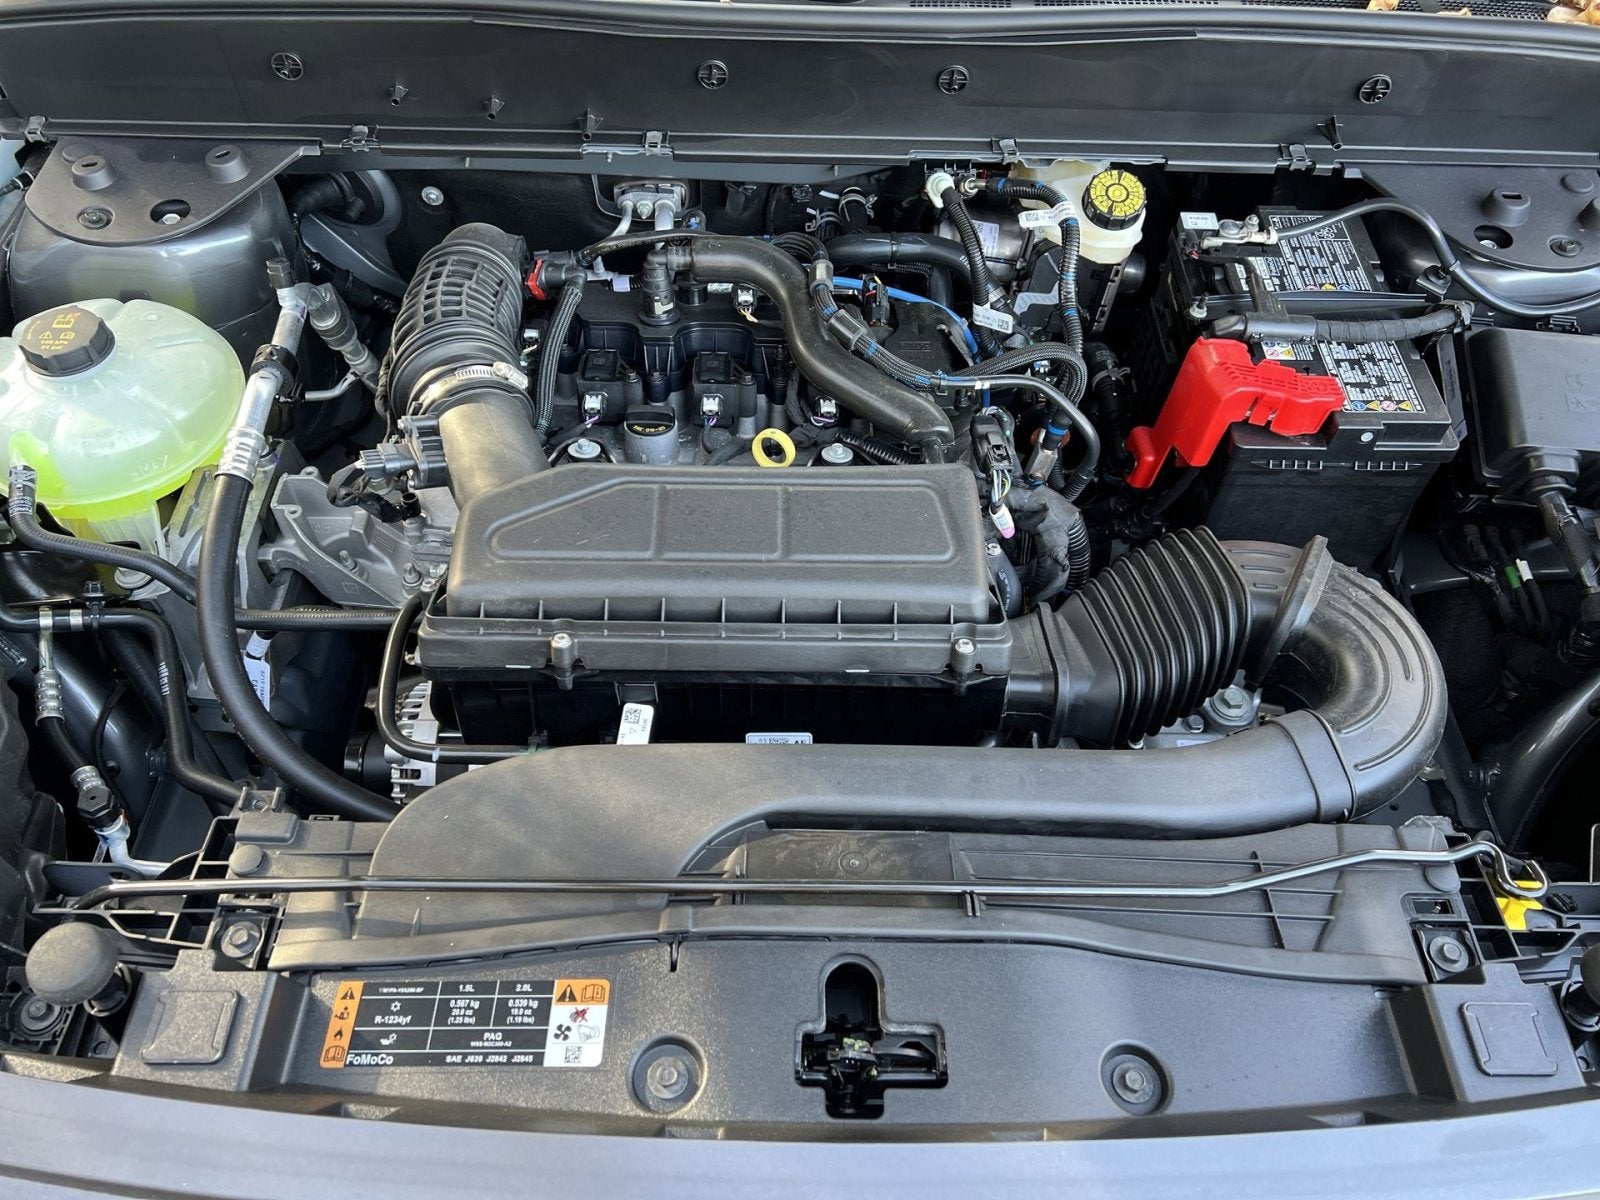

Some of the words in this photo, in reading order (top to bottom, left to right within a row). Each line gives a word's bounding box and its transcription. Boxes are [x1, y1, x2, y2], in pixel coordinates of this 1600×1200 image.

[459, 984, 475, 992] 1.5L
[515, 984, 532, 992] 2.0L
[450, 999, 468, 1007] 0.567
[470, 999, 480, 1008] kg
[508, 999, 528, 1007] 0.539
[528, 999, 538, 1008] kg
[374, 1015, 411, 1024] R-1234yf
[448, 1016, 463, 1024] (1.25
[464, 1016, 476, 1024] lbs)
[506, 1016, 521, 1024] (1.19
[522, 1016, 534, 1024] lbs)
[483, 1032, 502, 1040] PAG
[346, 1054, 394, 1066] FoMoCo
[445, 1054, 462, 1063] SAE
